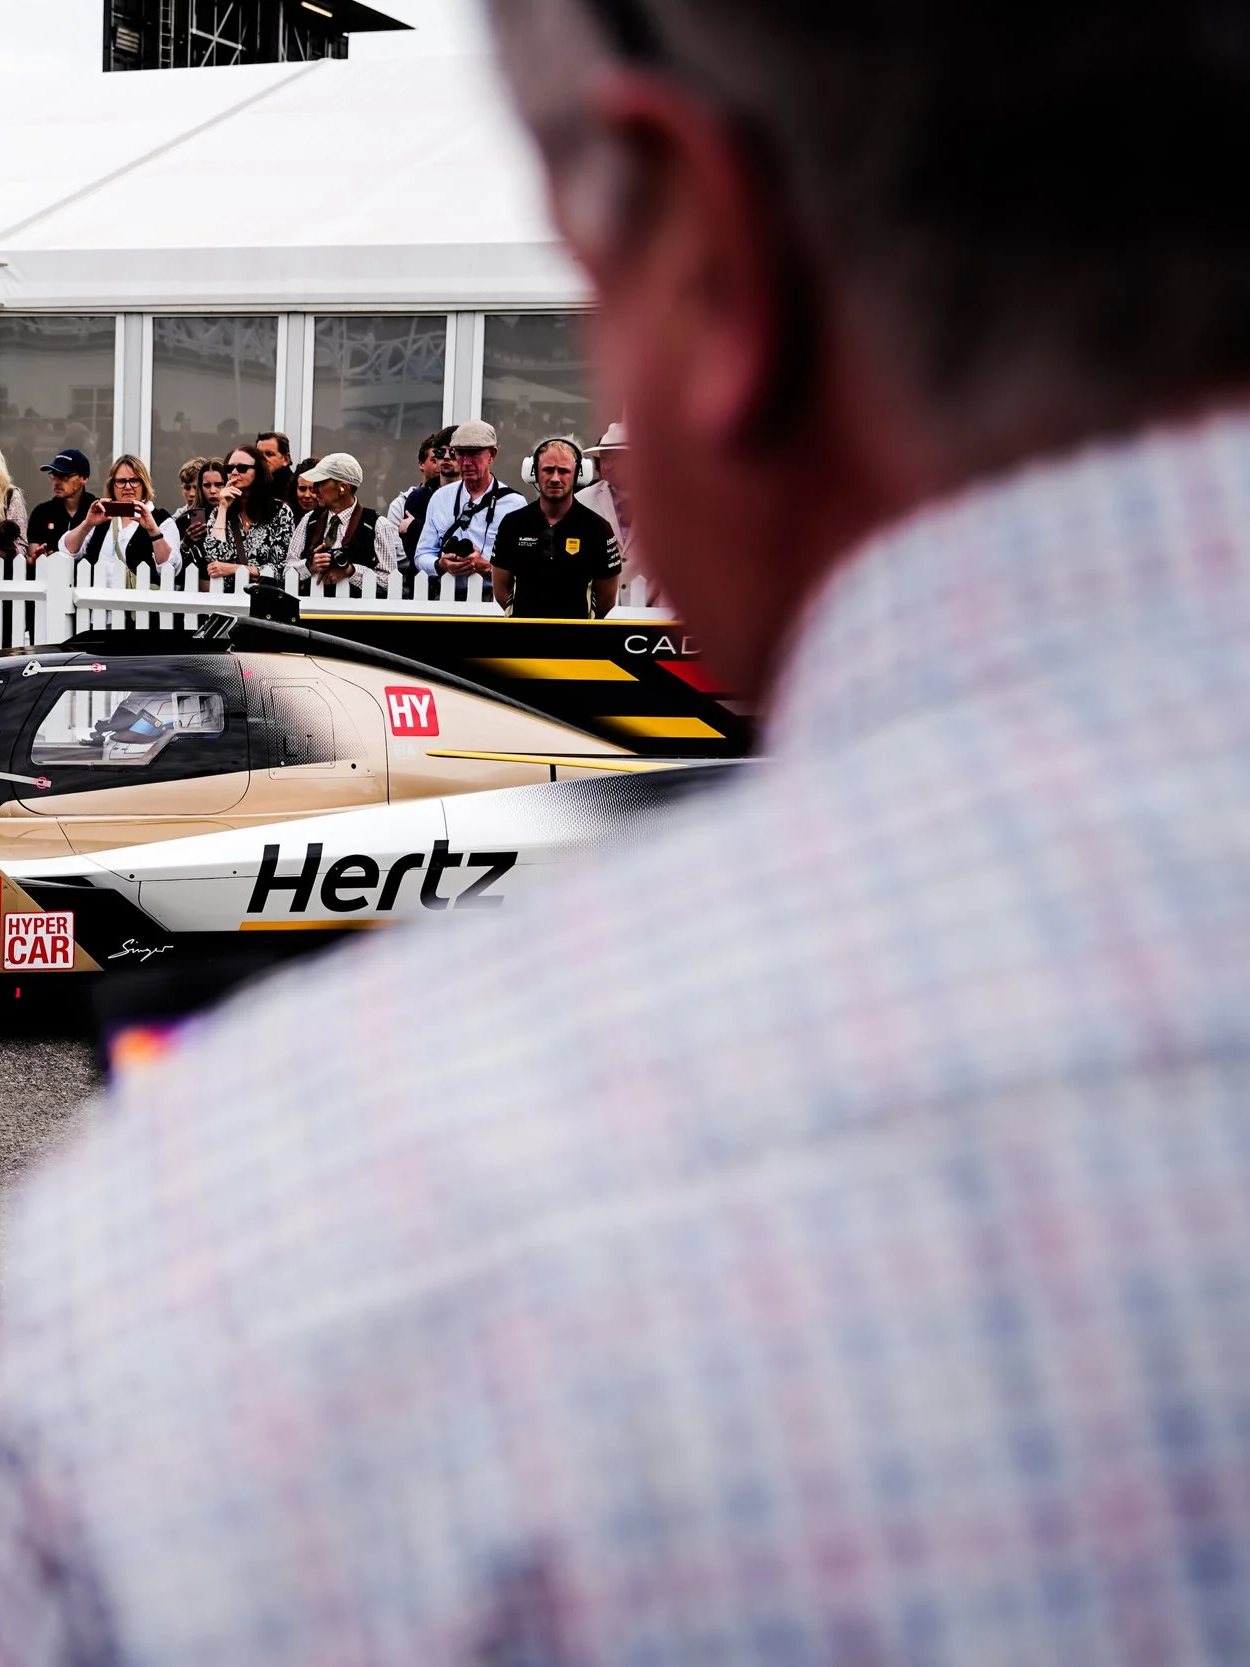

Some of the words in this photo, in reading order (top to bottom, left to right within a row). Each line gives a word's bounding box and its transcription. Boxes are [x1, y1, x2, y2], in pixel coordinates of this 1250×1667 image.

[388, 694, 431, 728] HY
[246, 839, 519, 913] Hertz
[8, 916, 68, 935] HYPER
[7, 935, 71, 965] CAR
